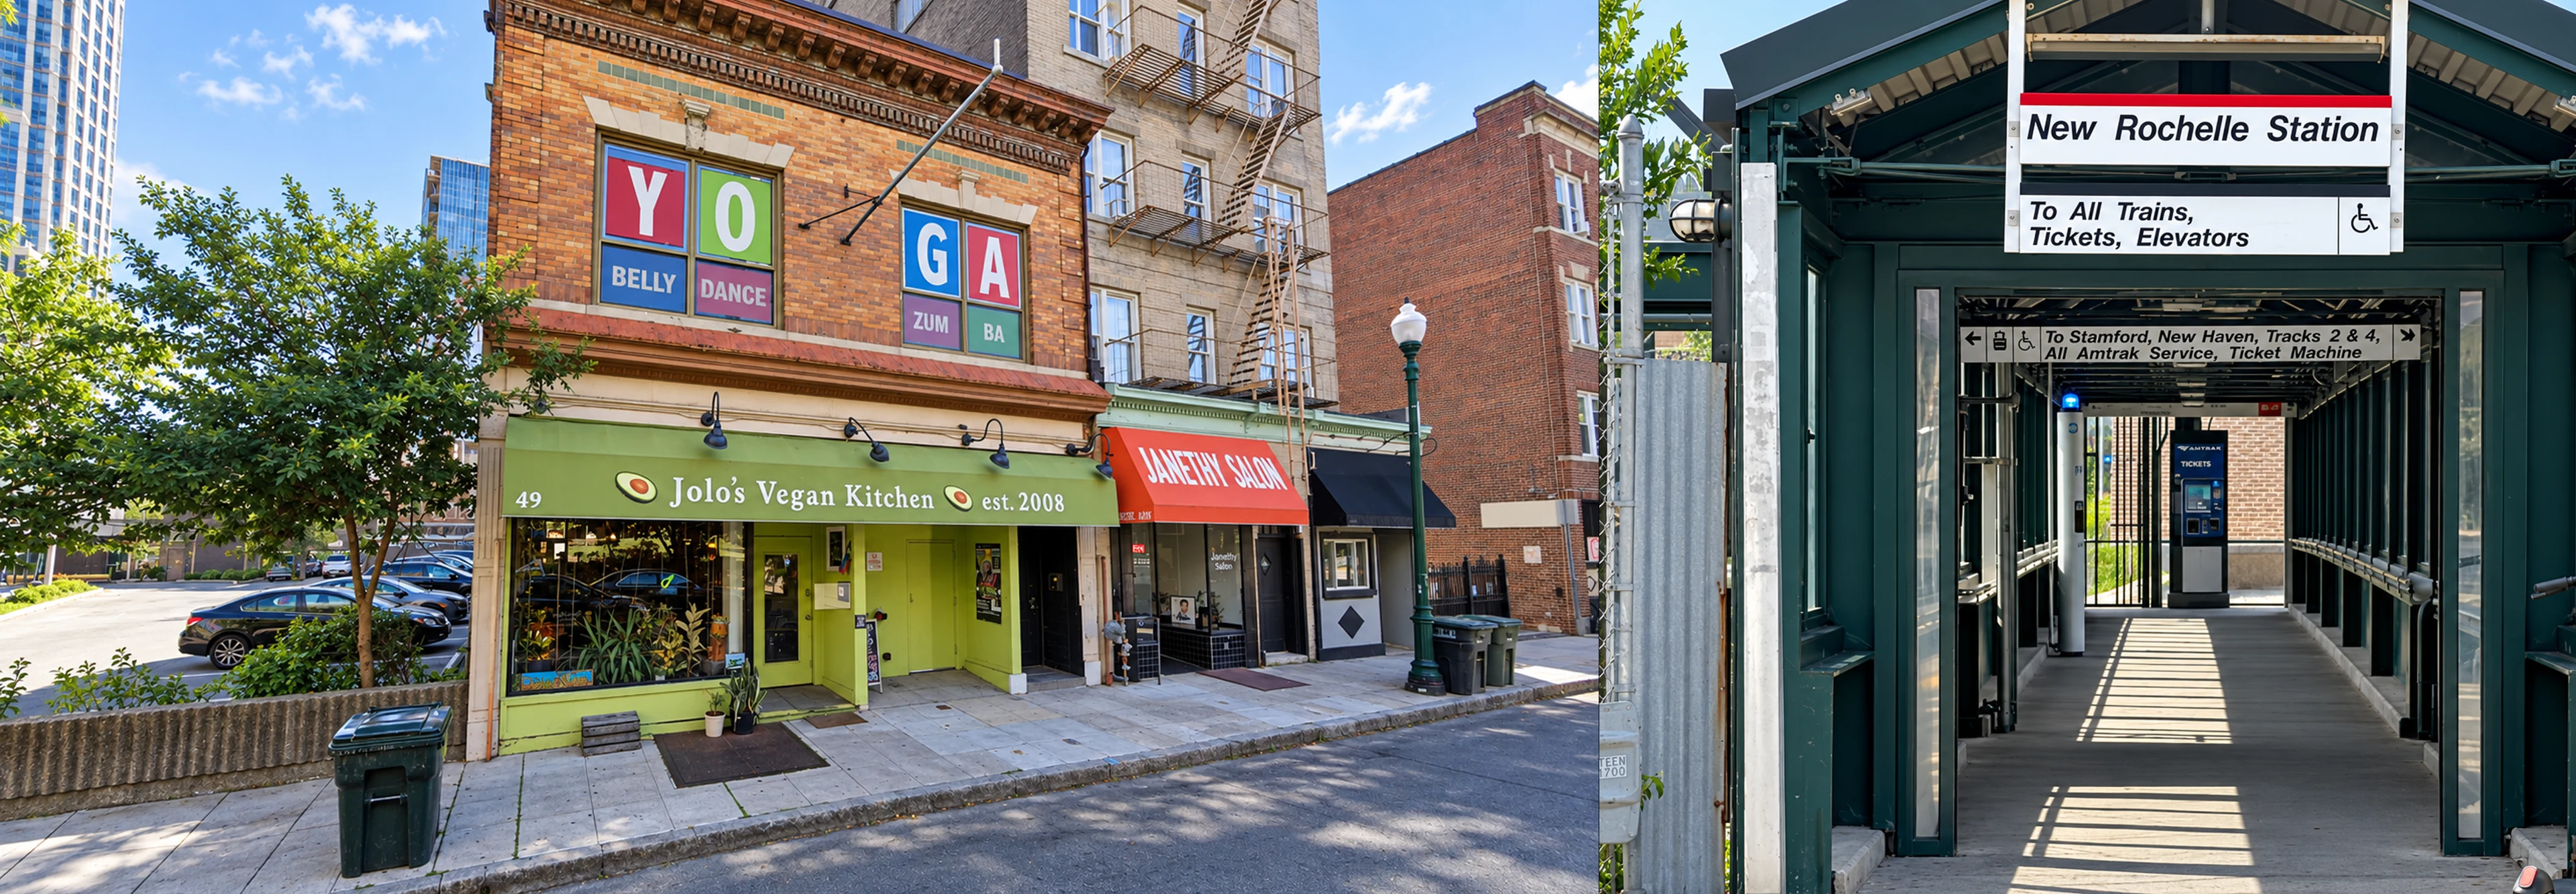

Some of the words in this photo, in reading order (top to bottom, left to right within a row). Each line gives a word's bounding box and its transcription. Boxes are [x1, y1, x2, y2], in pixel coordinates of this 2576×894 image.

[2027, 113, 2097, 141] New
[2115, 114, 2250, 142] Rochelle
[2267, 114, 2379, 143] Station
[2030, 201, 2057, 221] To
[2069, 201, 2102, 221] All
[2118, 201, 2194, 225] Trains,
[2030, 227, 2122, 250] Tickets,
[2136, 227, 2250, 248] Elevators
[612, 265, 677, 294] BELLY
[701, 279, 767, 307] DANCE
[913, 311, 949, 334] ZUM
[983, 323, 1005, 343] BA
[2045, 330, 2064, 343] To
[2069, 329, 2152, 345] Stamford,
[2158, 330, 2197, 343] New
[2202, 329, 2259, 345] Haven,
[2267, 329, 2321, 343] Tracks
[2329, 329, 2341, 342] 2
[2346, 329, 2358, 342] &
[2365, 329, 2380, 344] 4,
[2044, 347, 2068, 360] All
[2076, 347, 2140, 360] Amtrak
[2149, 346, 2218, 361] Service,
[2229, 346, 2281, 360] Ticket
[2290, 346, 2362, 359] Machine
[1138, 447, 1229, 488] JANETHY
[1224, 454, 1288, 491] SALON
[516, 491, 542, 509] 49
[670, 477, 745, 508] Jolo's
[756, 480, 836, 511] Vegan
[845, 485, 935, 509] Kitchen
[982, 494, 1014, 511] est.
[1019, 492, 1065, 512] 2008
